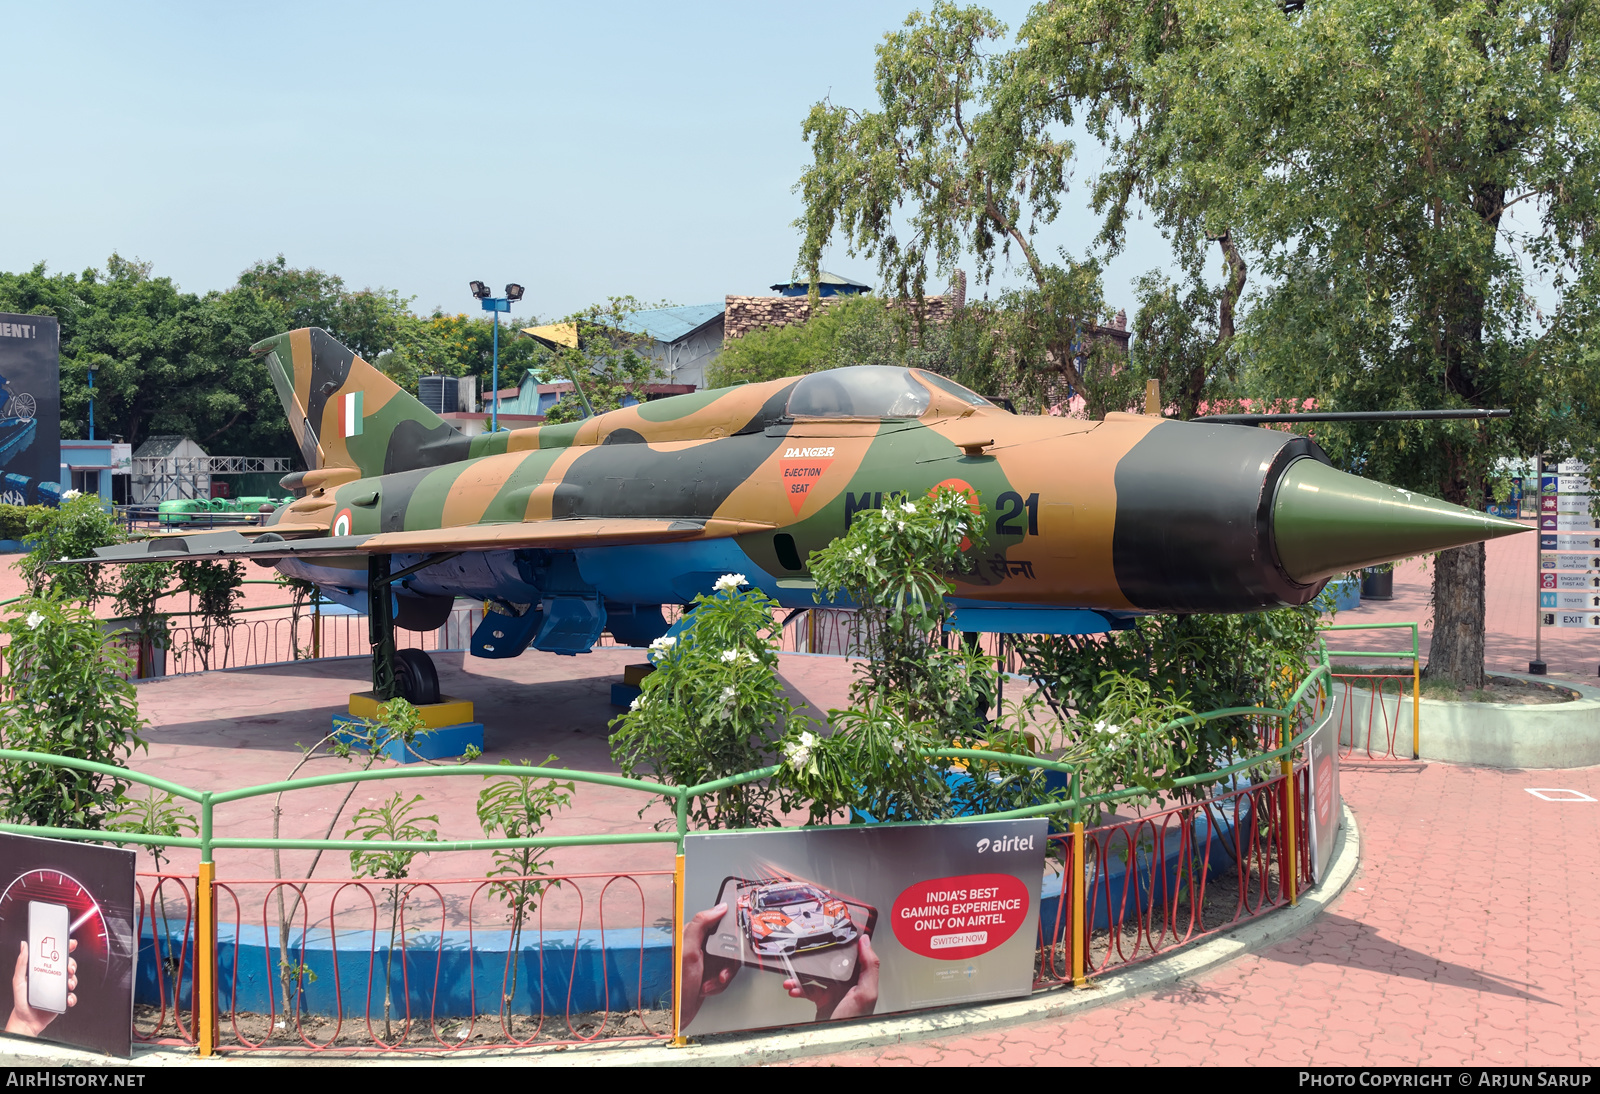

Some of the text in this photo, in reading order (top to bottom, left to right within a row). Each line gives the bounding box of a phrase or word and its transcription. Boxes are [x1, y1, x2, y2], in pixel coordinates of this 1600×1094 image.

[0, 322, 36, 338] ENT!
[784, 447, 835, 458] DANGER
[784, 468, 821, 477] EJECTION
[791, 484, 810, 493] SEAT
[995, 491, 1040, 536] 21
[987, 553, 1036, 579] सेना
[1563, 615, 1583, 624] EXIT
[992, 835, 1034, 852] airtel
[926, 887, 999, 903] INDIA'S BEST
[901, 899, 1021, 918] GAMING EXPERIENCE
[914, 913, 1006, 931] ONLY ON AIRTEL
[933, 933, 986, 946] SWITCH NOW
[33, 966, 62, 976] DOWNLOADED
